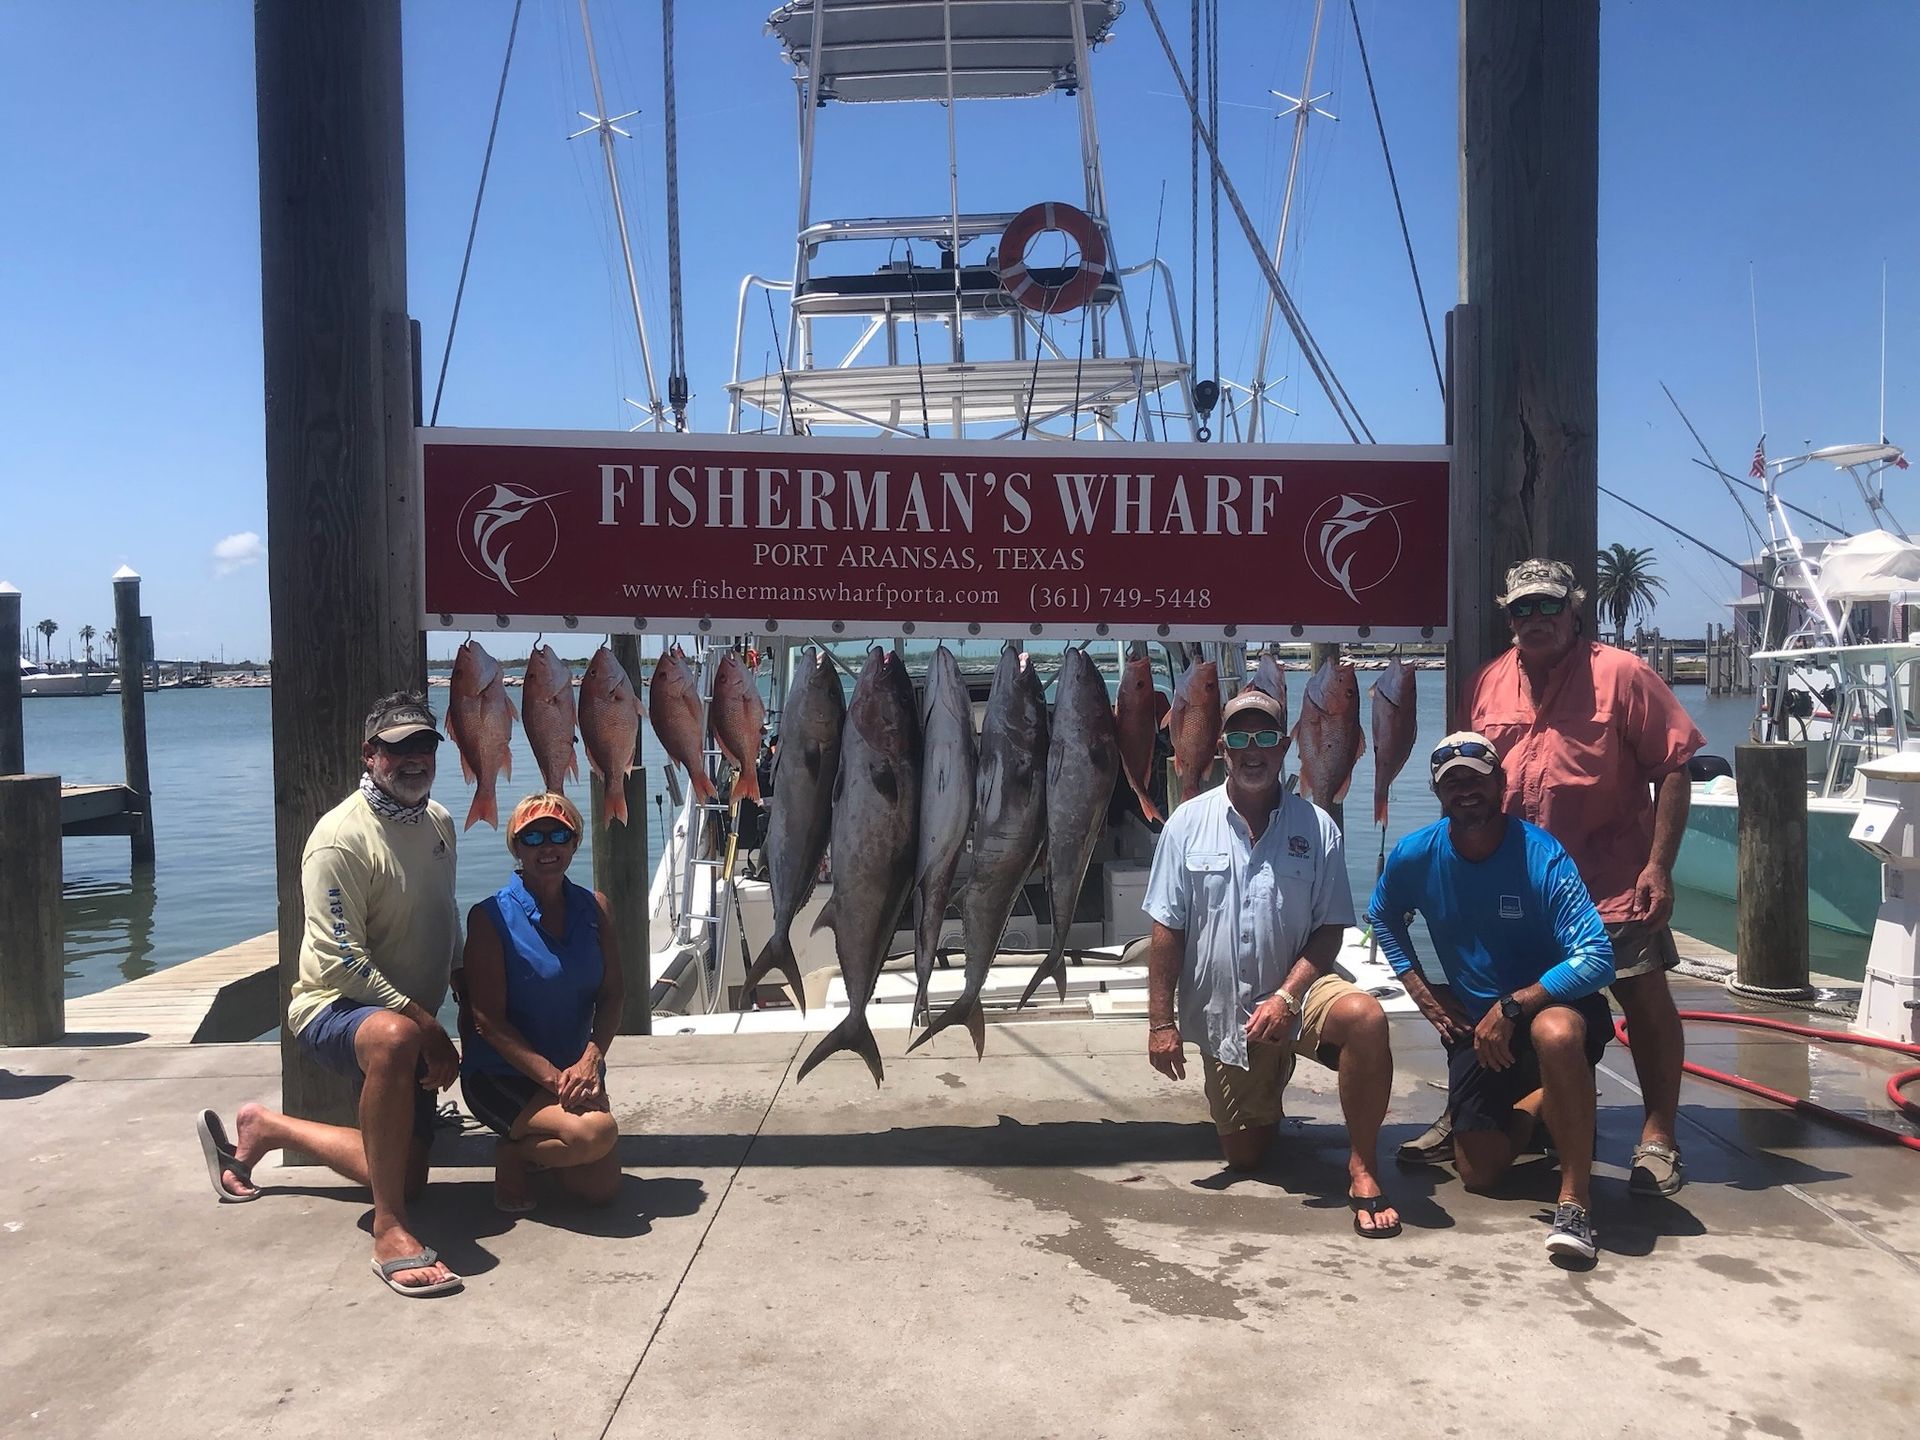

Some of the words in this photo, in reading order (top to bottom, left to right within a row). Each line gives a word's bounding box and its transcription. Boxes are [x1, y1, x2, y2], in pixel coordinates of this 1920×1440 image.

[597, 464, 1032, 535] FISHERMAN'S
[1053, 473, 1283, 536] WHARF
[753, 543, 828, 567] PORT
[837, 545, 983, 573] ARANSAS,
[993, 548, 1085, 571] TEXAS
[622, 578, 1000, 609] www.fishermanswharfporta.com
[1029, 583, 1091, 613] (361)
[1099, 587, 1212, 609] 749-5448
